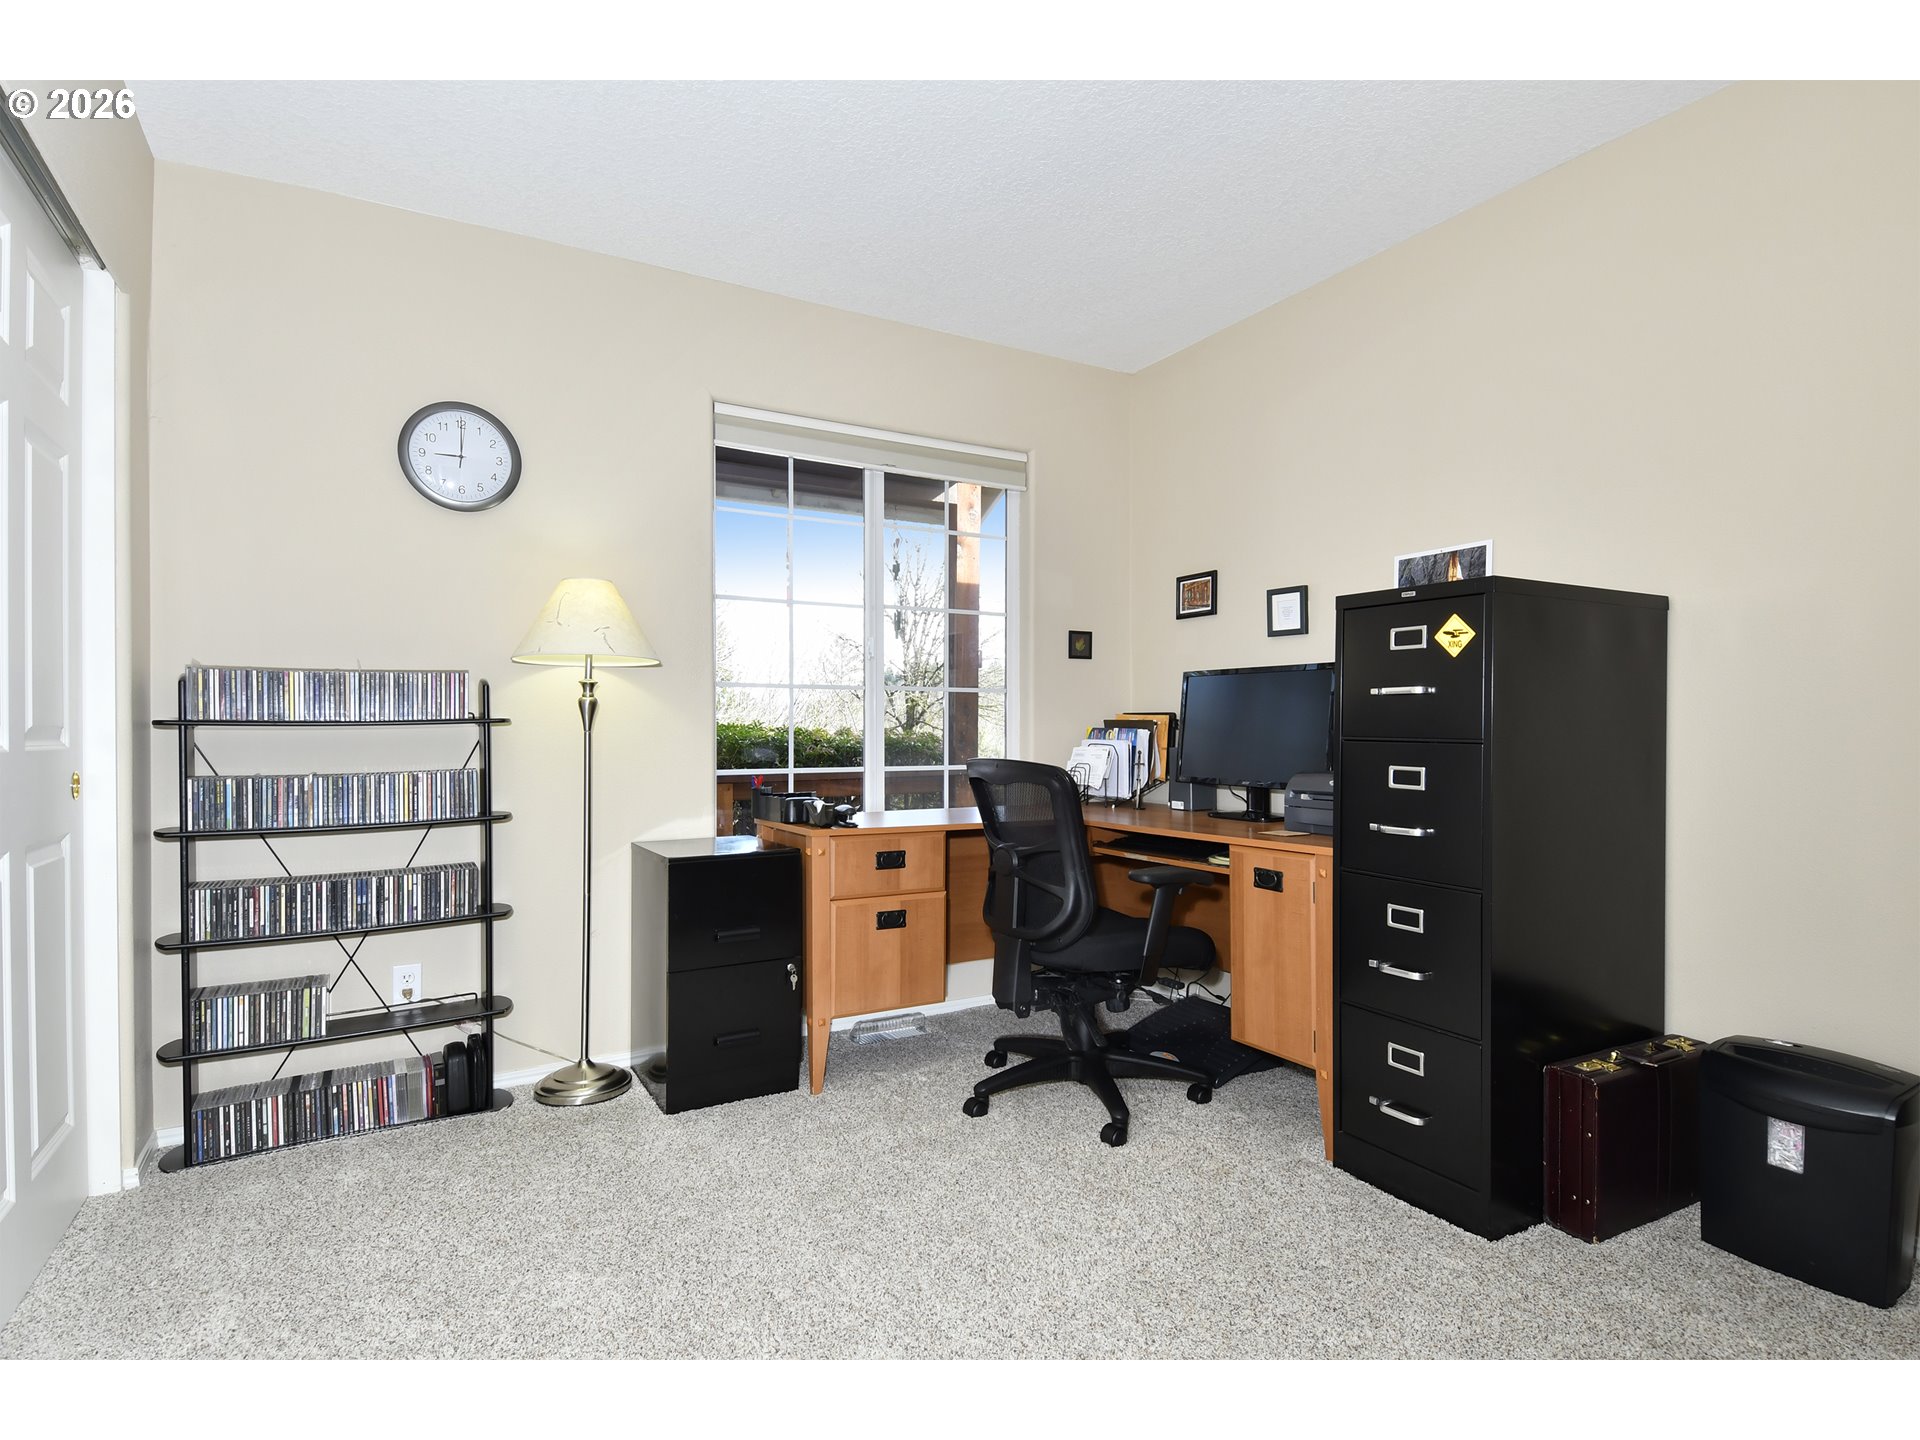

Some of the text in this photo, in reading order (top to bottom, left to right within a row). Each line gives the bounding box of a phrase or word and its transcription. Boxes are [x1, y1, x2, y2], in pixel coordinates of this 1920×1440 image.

[438, 422, 448, 431] 11
[456, 420, 467, 430] 12
[424, 433, 436, 443] 10
[489, 440, 497, 449] 2
[418, 448, 426, 457] 9
[496, 457, 503, 466] 3
[425, 465, 432, 475] 8
[491, 473, 497, 482] 4
[458, 485, 466, 494] 6
[477, 483, 484, 492] 5
